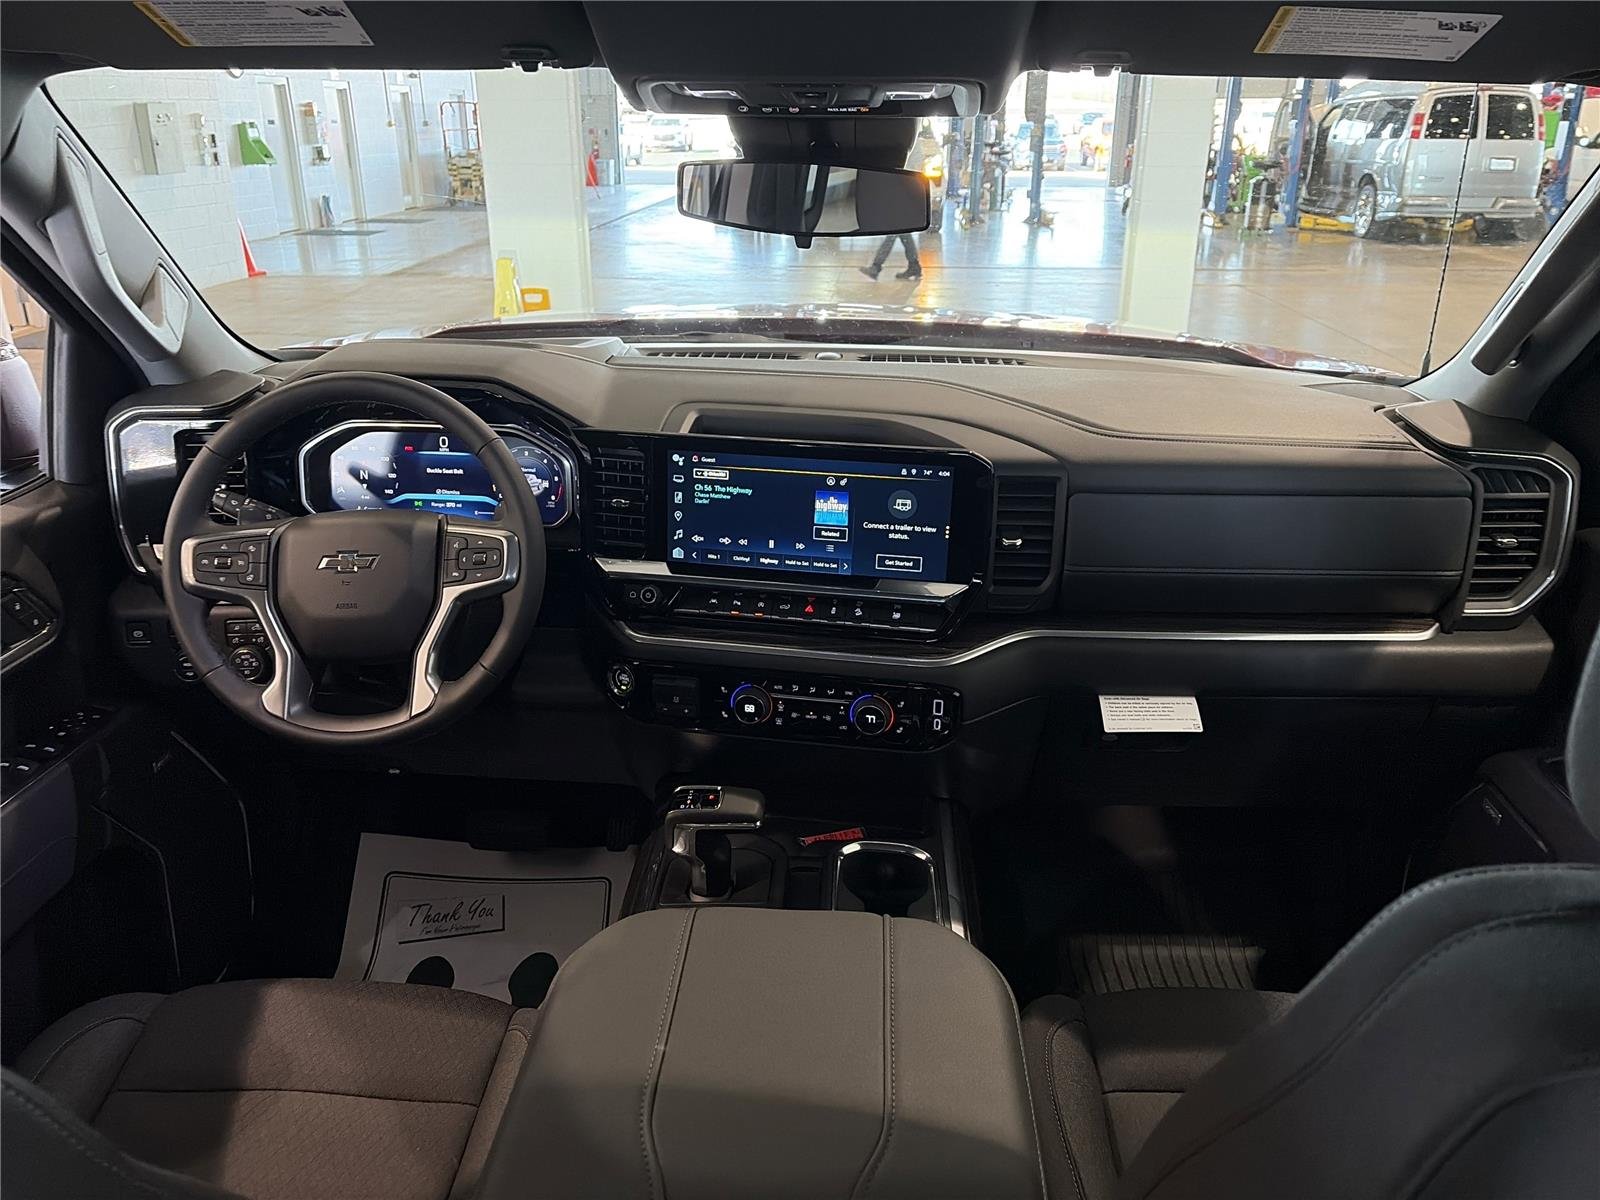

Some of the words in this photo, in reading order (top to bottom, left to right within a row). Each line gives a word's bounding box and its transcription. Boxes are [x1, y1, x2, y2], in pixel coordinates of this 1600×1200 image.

[439, 436, 449, 448] 0
[359, 470, 369, 480] N
[694, 483, 704, 492] Ch
[704, 484, 713, 492] 56
[714, 485, 726, 493] The
[726, 486, 753, 497] Highway
[710, 492, 731, 500] Matthew
[815, 499, 848, 513] highway
[863, 521, 890, 531] Connect
[895, 522, 914, 532] trailer
[922, 525, 937, 533] view
[821, 529, 840, 538] Related
[888, 532, 910, 540] status.
[759, 557, 779, 565] Highway
[885, 559, 894, 567] Get
[895, 559, 913, 568] Started
[409, 901, 464, 927] Thank
[468, 898, 494, 920] You
